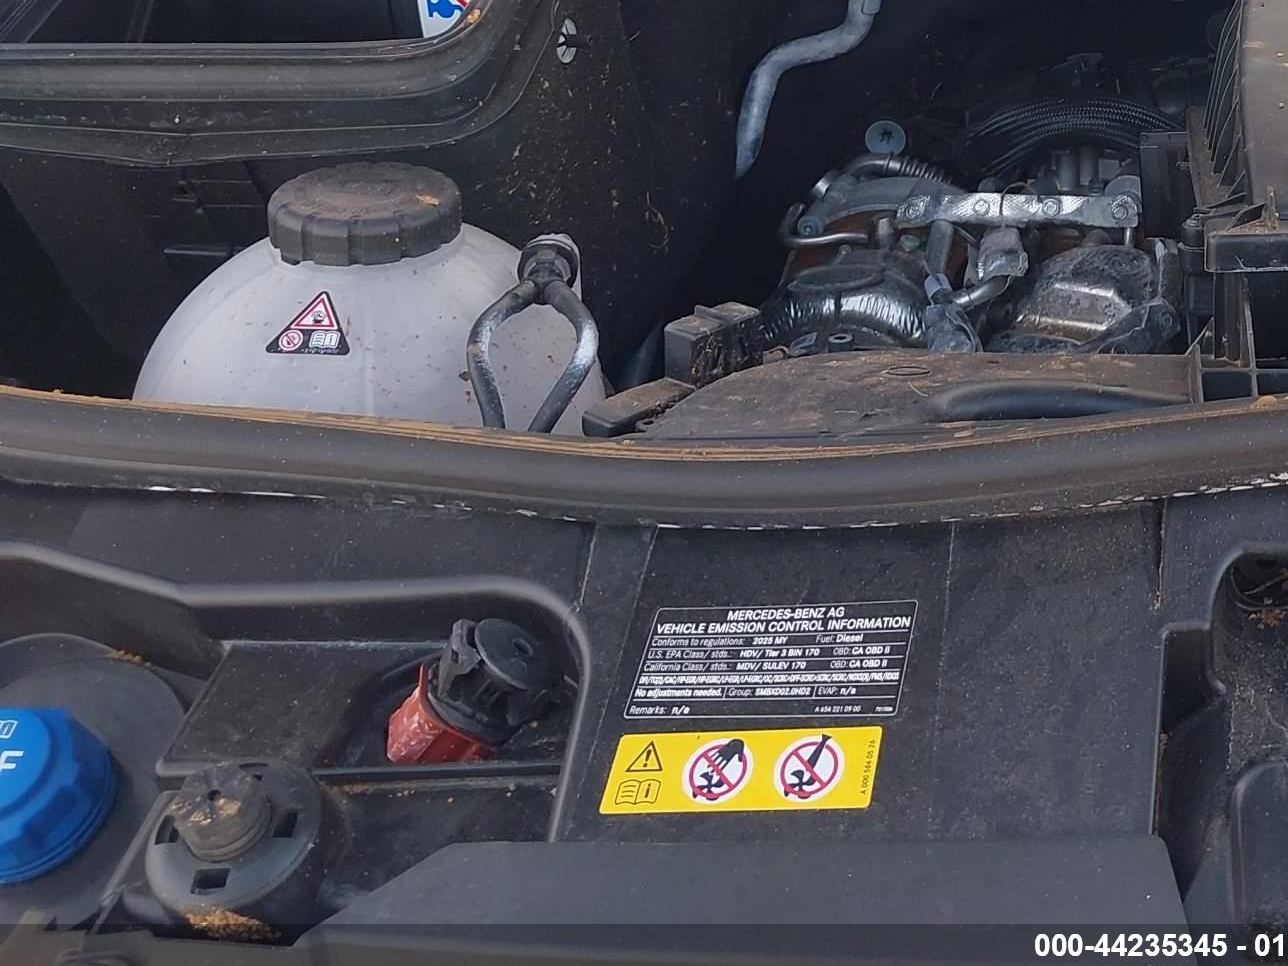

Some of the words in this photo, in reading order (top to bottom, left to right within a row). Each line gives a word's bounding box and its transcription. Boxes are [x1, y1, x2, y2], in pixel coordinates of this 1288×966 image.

[727, 607, 827, 621] MERCEDES-BENZ
[827, 606, 846, 618] AG
[656, 623, 707, 634] VEHICLE
[707, 622, 766, 634] EMISSION
[767, 621, 825, 633] CONTROL
[827, 616, 912, 630] INFORMATION
[651, 638, 690, 646] Conforms
[690, 638, 699, 646] to
[752, 636, 773, 645] 2025
[774, 636, 789, 644] MY
[815, 634, 836, 643] Fuel:
[836, 633, 864, 643] Diesel
[647, 650, 664, 659] U.S.
[665, 650, 682, 659] EPA
[682, 650, 711, 659] Class/
[765, 649, 780, 657] Tier
[805, 648, 821, 656] 170
[852, 646, 864, 655] CA
[865, 646, 884, 654] OBD
[643, 662, 681, 672] California
[682, 662, 710, 671] Class/
[762, 661, 790, 670] SULEV
[791, 661, 807, 669] 170
[849, 659, 861, 668] CA
[862, 659, 881, 668] OBD
[634, 688, 647, 697] No
[646, 688, 693, 699] adjustments
[728, 687, 754, 697] Group:
[629, 705, 668, 715] Remarks:
[671, 705, 691, 715] n/a
